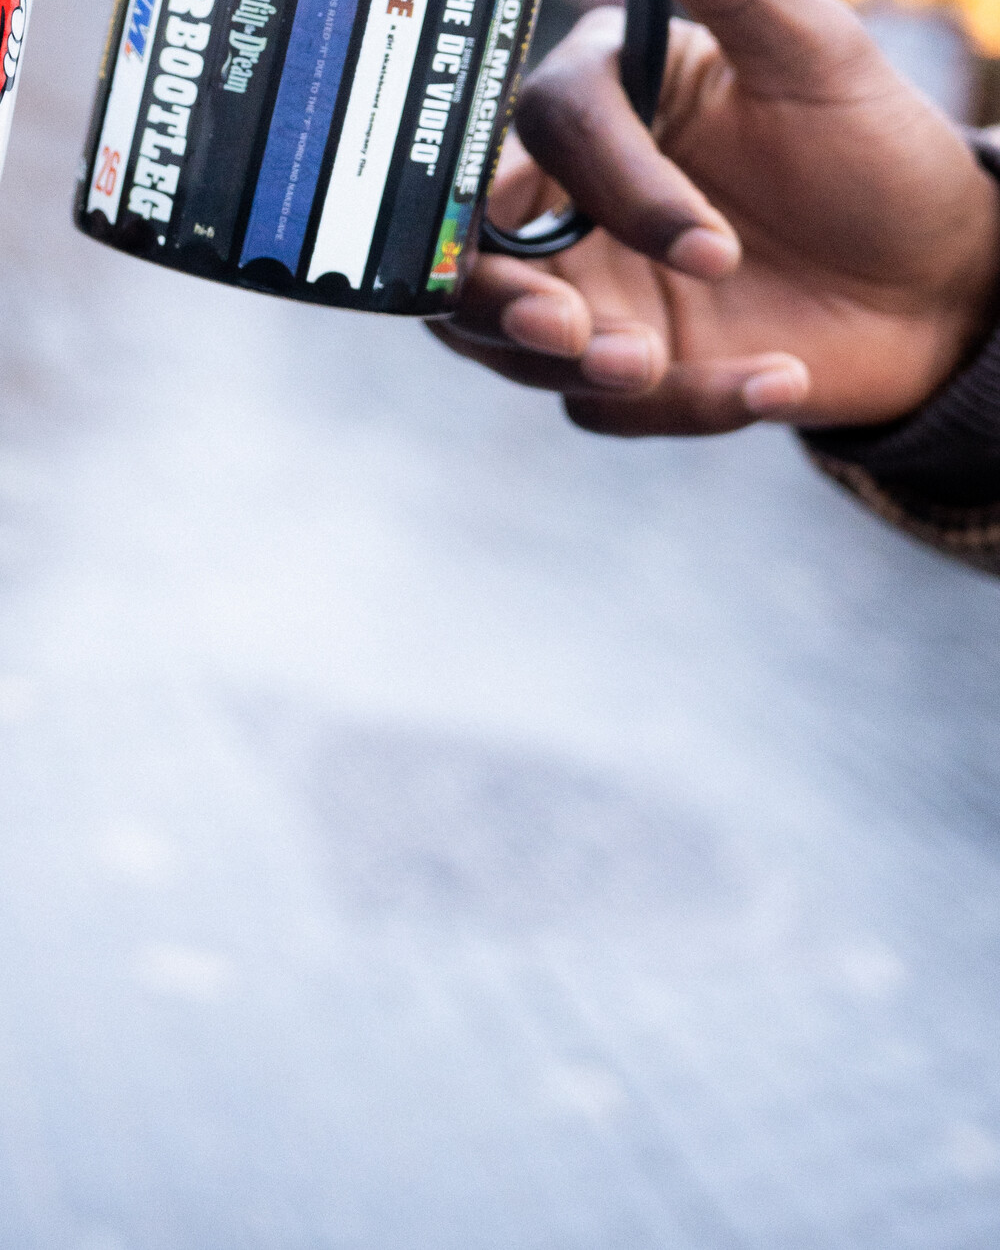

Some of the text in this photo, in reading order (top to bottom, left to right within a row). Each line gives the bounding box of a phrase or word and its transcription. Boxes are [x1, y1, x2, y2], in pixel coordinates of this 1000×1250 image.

[322, 8, 335, 40] RATED
[385, 33, 394, 50] girl
[432, 32, 465, 73] DC
[221, 29, 267, 93] Dream
[314, 59, 324, 77] DUE
[310, 81, 319, 94] TO
[372, 52, 389, 108] skateboard
[305, 96, 316, 113] THE
[459, 45, 509, 193] MACHINE
[360, 111, 375, 154] company
[410, 83, 455, 175] VIDEO"
[295, 132, 307, 160] WORD
[289, 161, 300, 181] AND
[356, 158, 366, 176] film
[281, 182, 295, 214] NAKED
